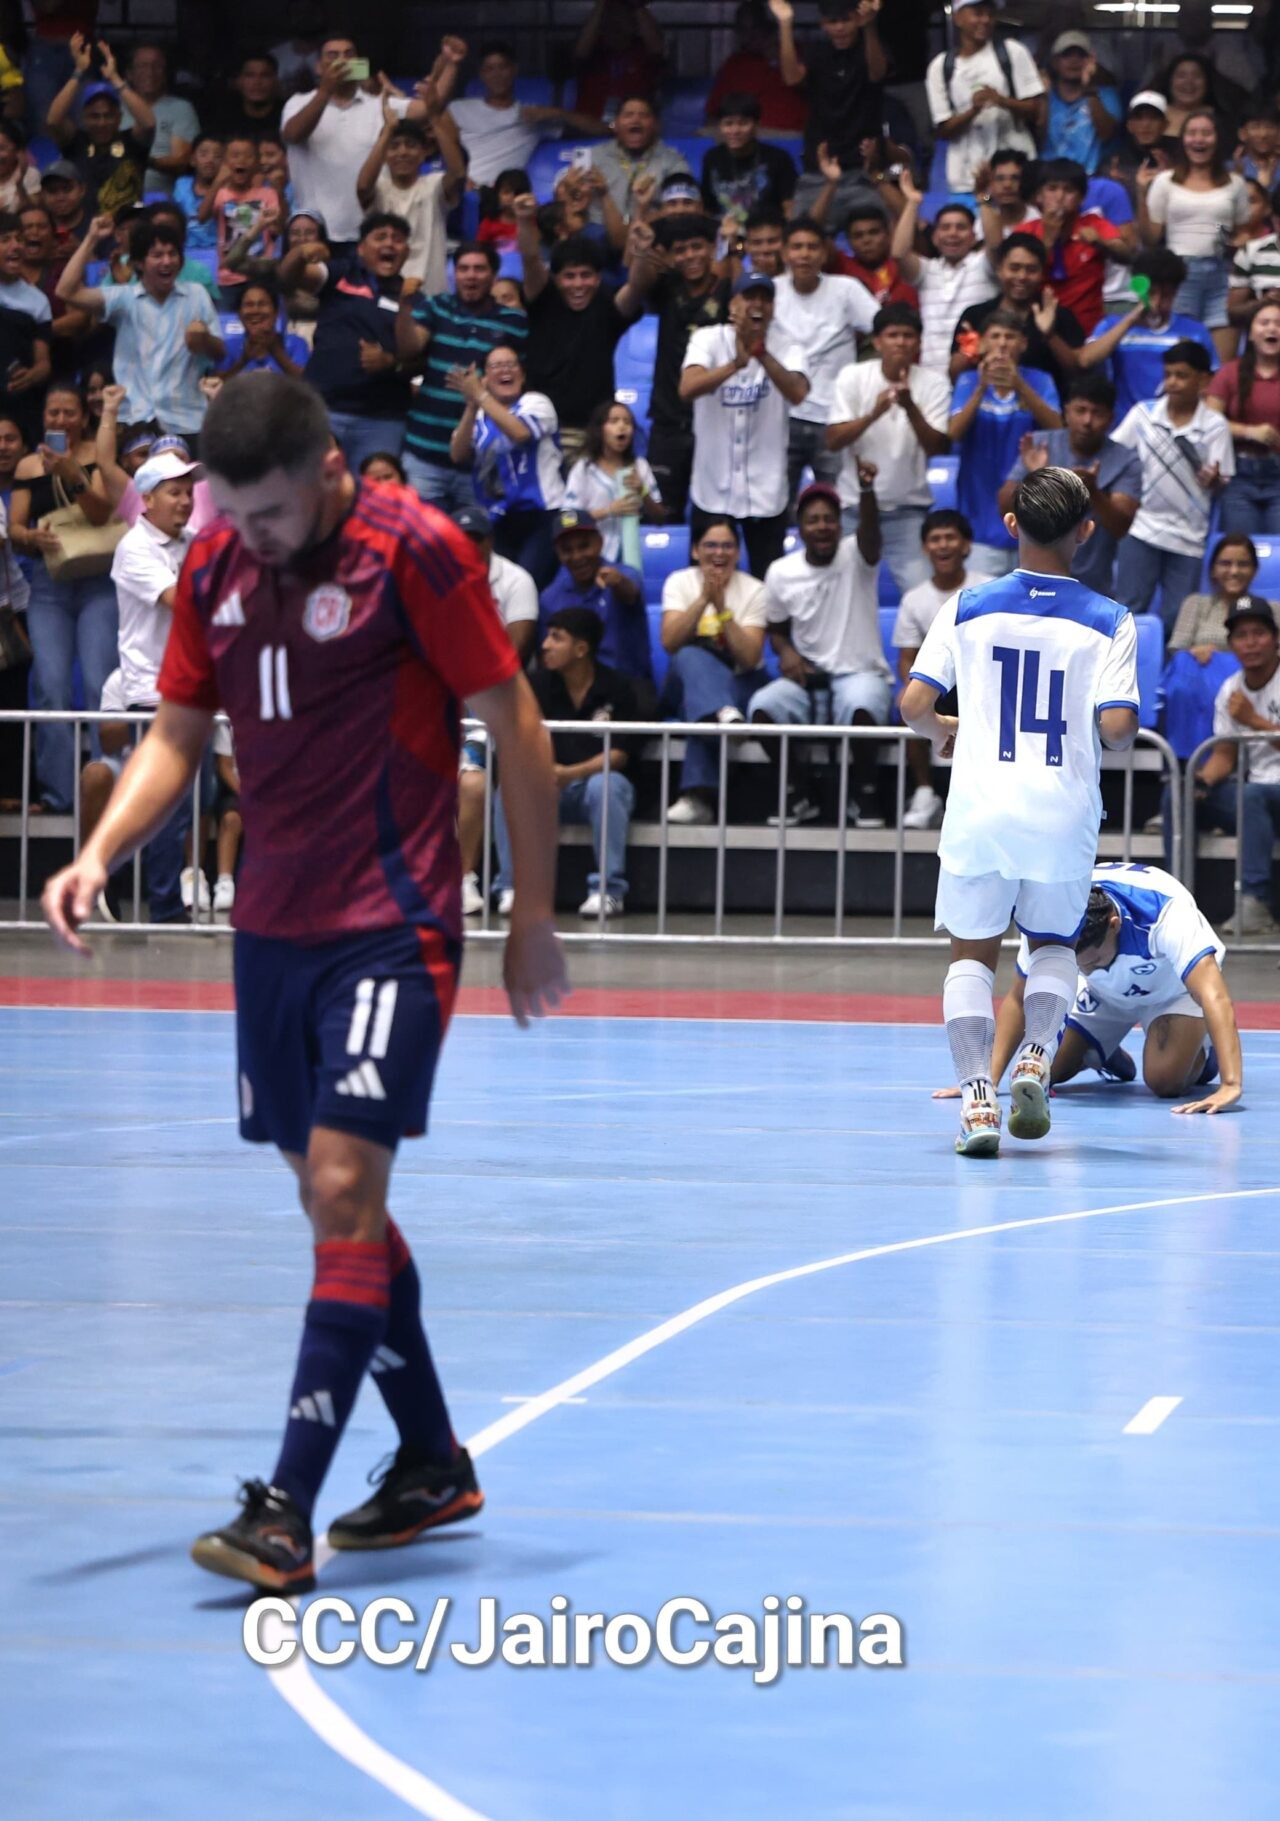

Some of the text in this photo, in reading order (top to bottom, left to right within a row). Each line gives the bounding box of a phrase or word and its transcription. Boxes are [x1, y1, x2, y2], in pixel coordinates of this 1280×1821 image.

[259, 645, 292, 720] 11
[992, 645, 1067, 767] 14
[345, 978, 398, 1058] 11
